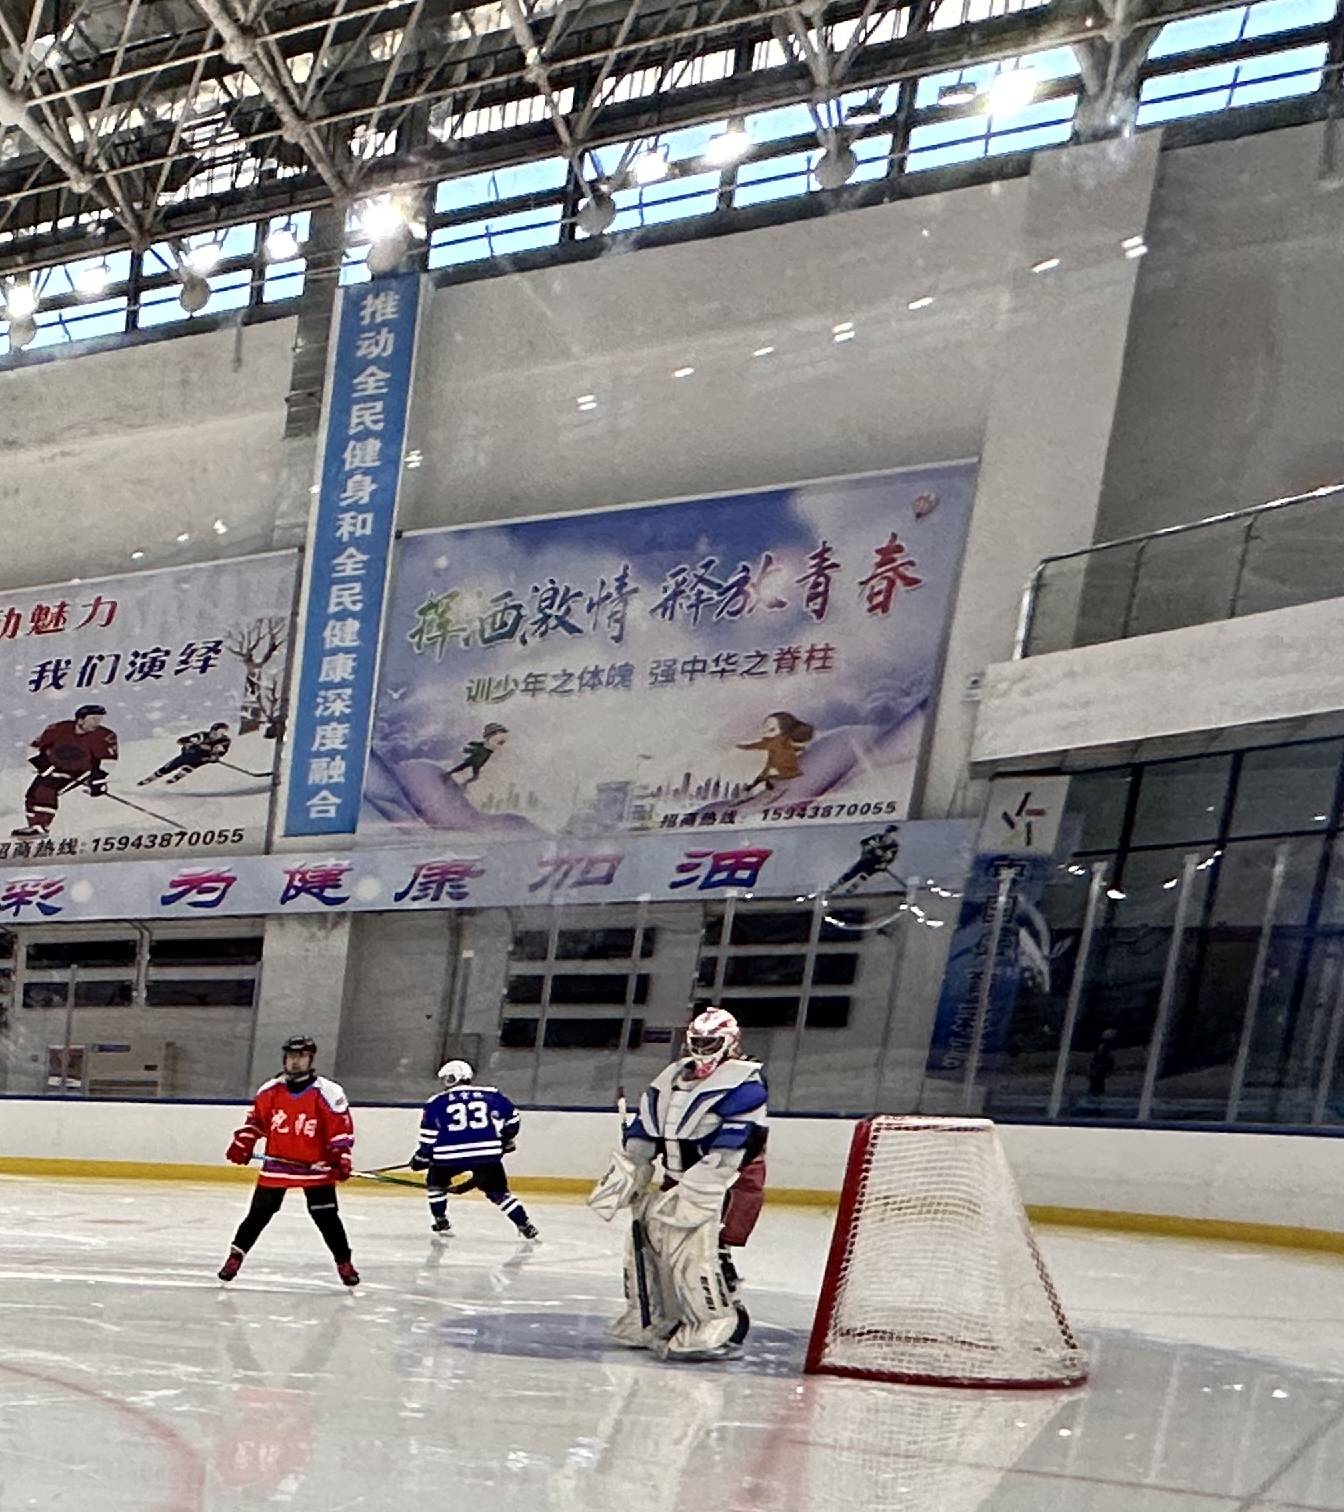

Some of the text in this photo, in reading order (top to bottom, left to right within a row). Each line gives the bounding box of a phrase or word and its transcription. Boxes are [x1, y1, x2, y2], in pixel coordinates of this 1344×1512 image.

[306, 290, 401, 820] 推动全民健身和全民健康深度融合
[408, 531, 927, 662] 挥洒激情 释放青春
[28, 640, 224, 693] 我们演绎
[648, 643, 837, 684] 强中华之脊柱
[446, 1101, 488, 1132] 33
